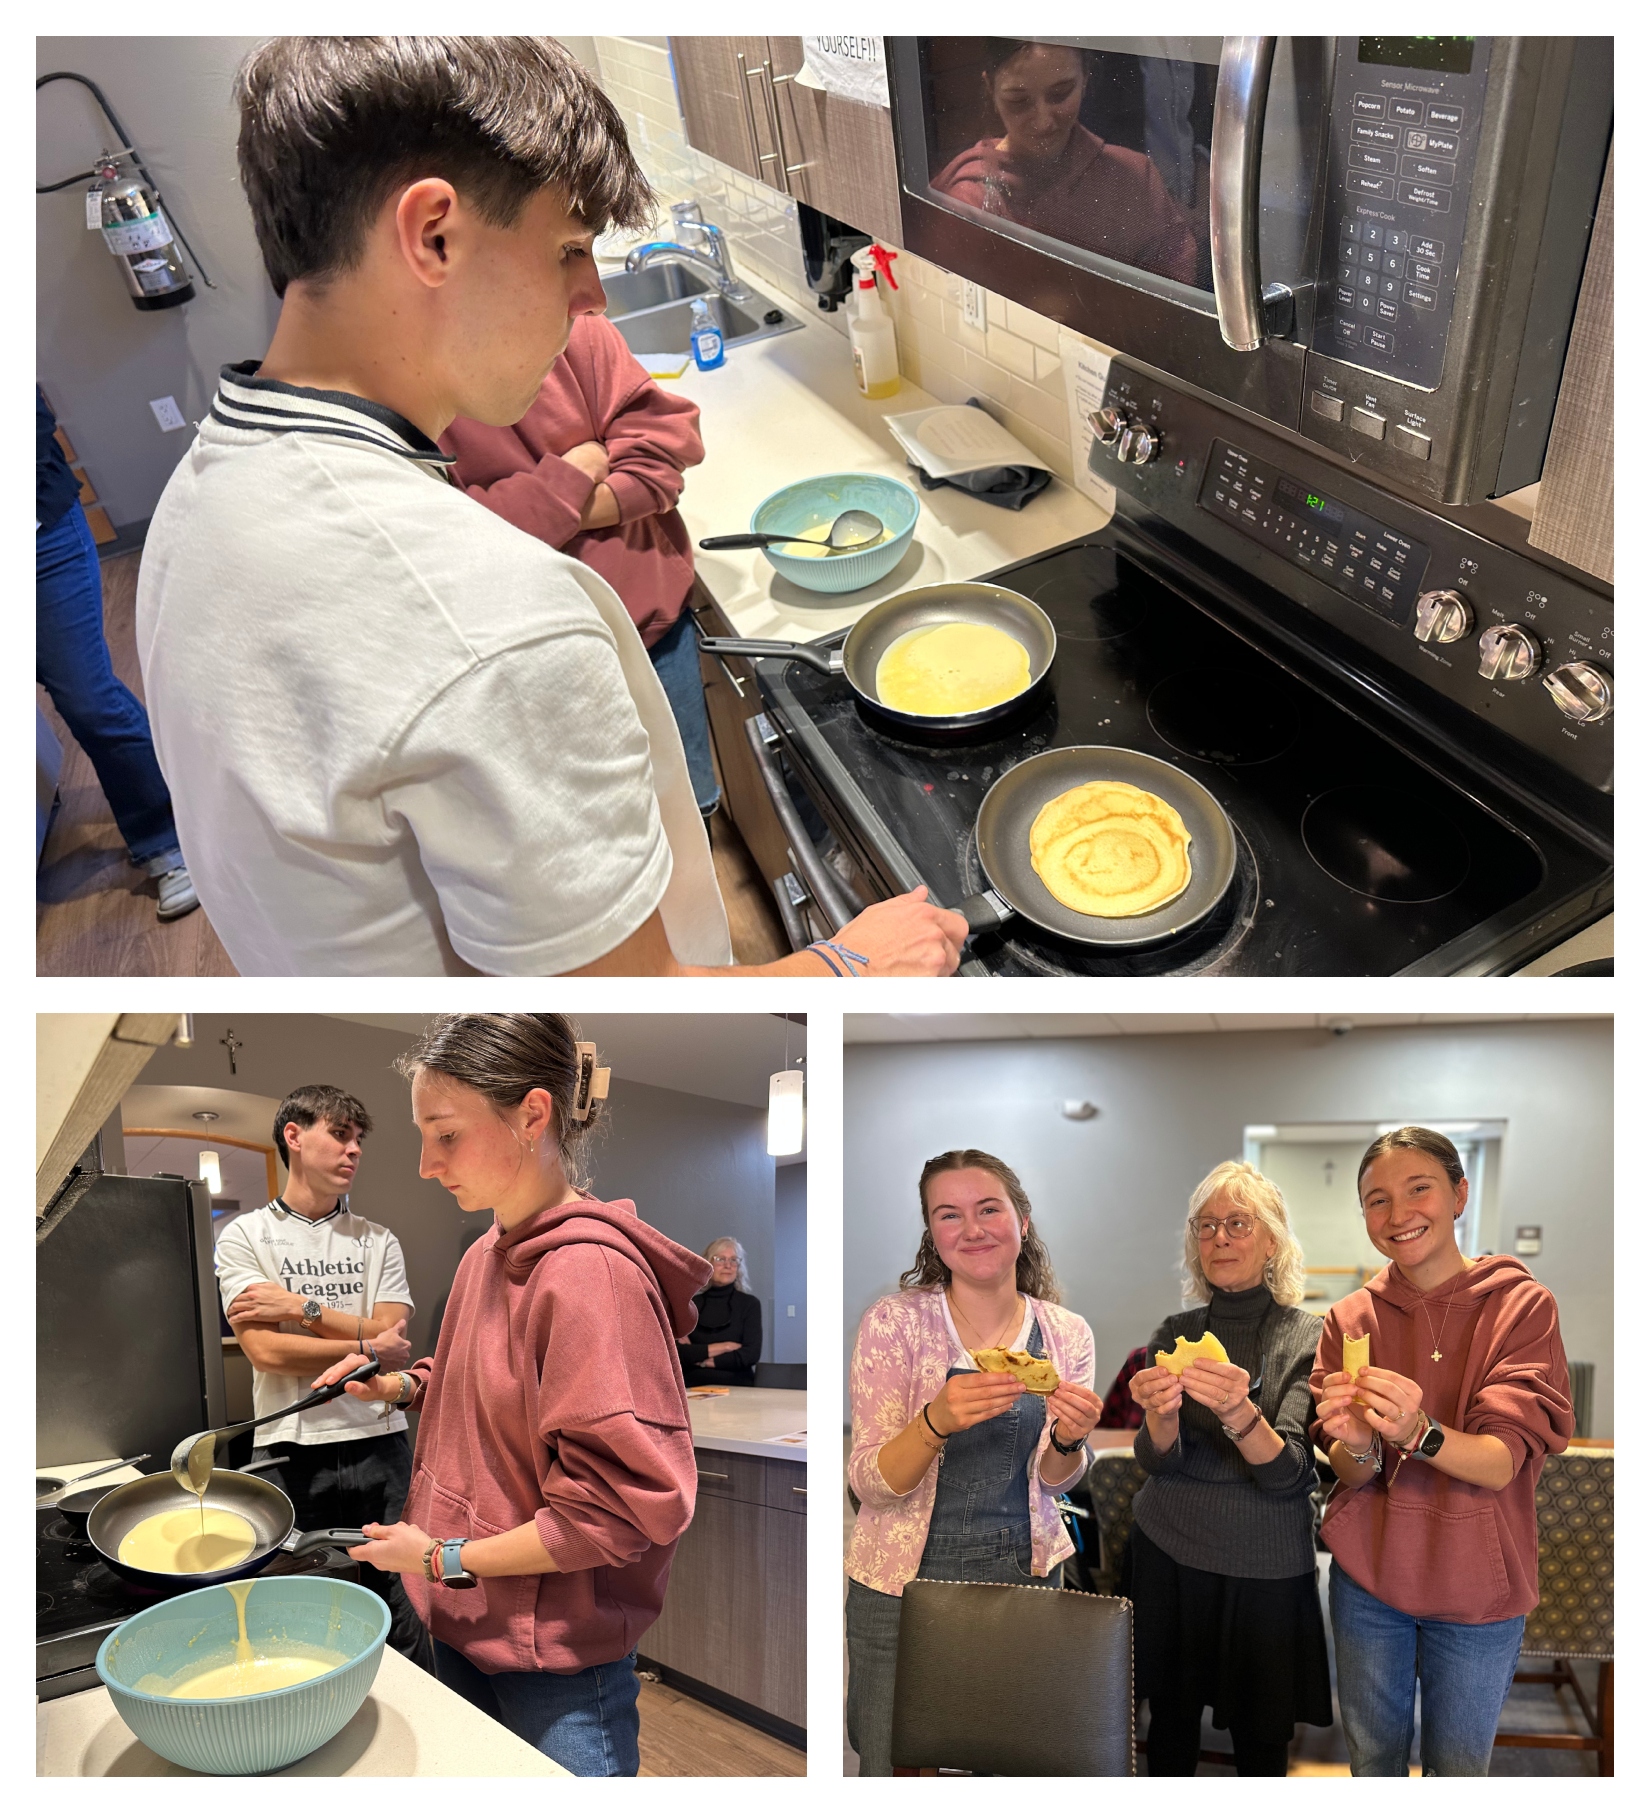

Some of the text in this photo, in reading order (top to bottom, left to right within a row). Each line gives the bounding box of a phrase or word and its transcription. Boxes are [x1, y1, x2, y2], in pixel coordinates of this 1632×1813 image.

[817, 36, 876, 62] YOURSELF!!
[1381, 80, 1439, 94] Sensor Microwave
[1358, 101, 1381, 110] Popcorn
[1396, 106, 1416, 115] Potato
[1430, 111, 1459, 122] Beverage
[1357, 127, 1394, 140] Family Snacks
[1429, 139, 1453, 150] MyPlate
[1363, 154, 1381, 164] Steam
[1417, 165, 1437, 174] Soften
[1360, 180, 1380, 189] Reheat
[1413, 188, 1435, 198] Defrost
[1408, 194, 1438, 206] Weight/Time
[1356, 206, 1396, 221] Express Cook
[1349, 224, 1354, 233] 1
[1370, 230, 1376, 239] 2
[1393, 236, 1399, 245] 3
[1421, 241, 1433, 249] Add
[1346, 248, 1353, 256] 4
[1425, 250, 1436, 258] Sec
[1367, 253, 1374, 262] 5
[1389, 259, 1396, 268] 6
[1416, 264, 1431, 273] Cook
[1344, 270, 1350, 278] 7
[1416, 272, 1430, 280] Time
[1365, 276, 1371, 285] 8
[1386, 282, 1393, 291] 9
[1338, 287, 1353, 297] Power
[1408, 290, 1432, 302] Settings
[1362, 298, 1369, 307] 0
[1380, 301, 1396, 312] Power
[1380, 308, 1394, 318] Saver
[1339, 319, 1356, 329] Cancel
[1372, 330, 1386, 340] Start
[1370, 339, 1386, 349] Pause
[1323, 376, 1338, 386] Timer
[1365, 394, 1377, 403] Vent
[1366, 400, 1375, 409] Fan
[1404, 409, 1426, 423] Surface
[1407, 418, 1421, 428] Light
[1306, 494, 1325, 512] 1:21
[1355, 531, 1367, 541] Start
[1383, 531, 1411, 550] Lower Oven
[1458, 577, 1469, 586] Off
[1491, 608, 1505, 619] Melt
[1525, 611, 1537, 621] Off
[1547, 637, 1555, 645] Hi
[1568, 635, 1589, 648] Burner
[1574, 631, 1591, 643] Small
[1568, 648, 1577, 656] Hi
[1598, 648, 1612, 659] Off
[1492, 687, 1505, 698] Rear
[1561, 726, 1578, 741] Front
[280, 1257, 364, 1277] Athletic
[283, 1277, 364, 1301] League
